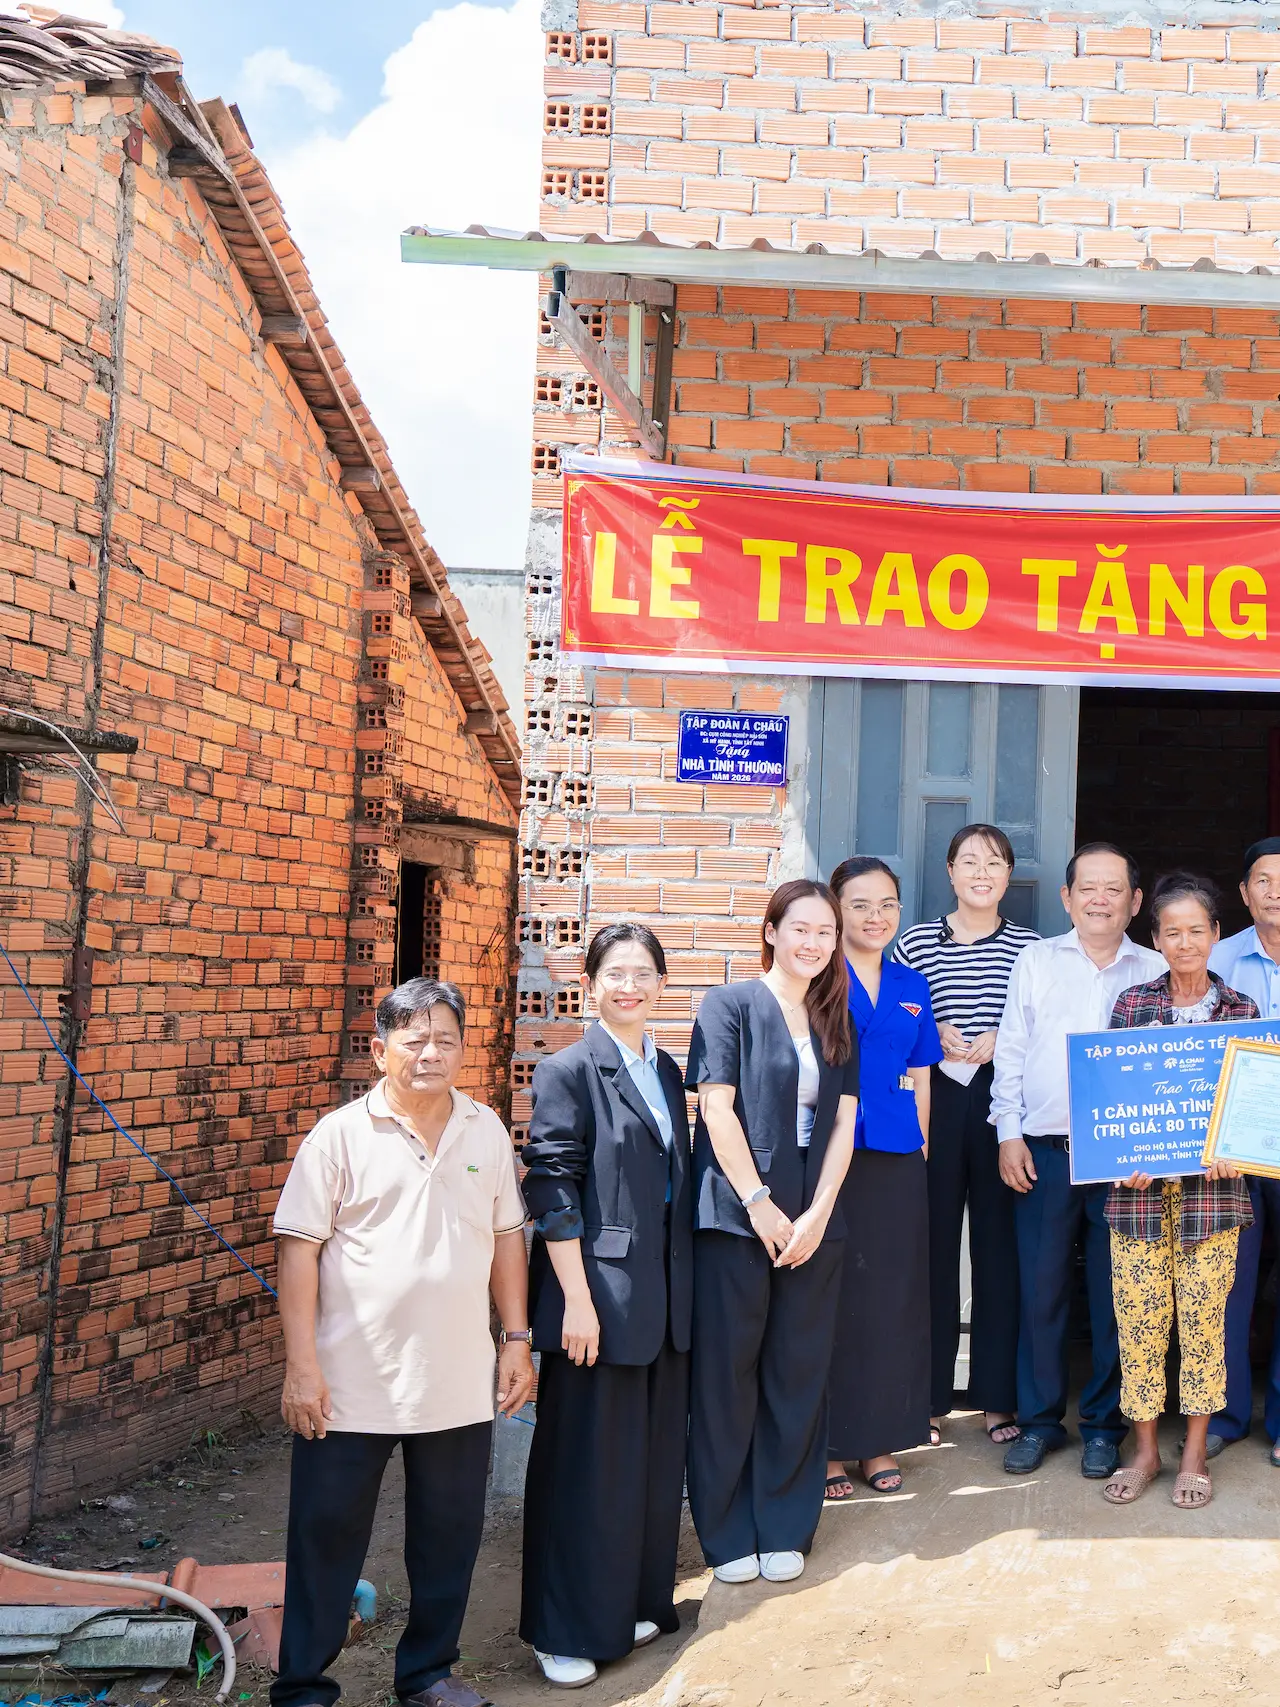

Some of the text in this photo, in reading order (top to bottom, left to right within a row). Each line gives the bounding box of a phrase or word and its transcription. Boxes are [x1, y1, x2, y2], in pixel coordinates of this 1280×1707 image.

[590, 496, 703, 620] LỄ
[741, 538, 990, 631] TRAO
[1021, 543, 1268, 660] TẶNG
[686, 716, 783, 732] TẬP ĐOÀN Á CHÂU
[715, 744, 750, 758] Tặng
[682, 756, 782, 774] NHÀ TÌNH THƯƠNG
[711, 772, 751, 782] NĂM 2026
[1085, 1045, 1112, 1061] TẬP
[1116, 1041, 1158, 1056] ĐOÀN
[1162, 1037, 1205, 1053] QUỐC
[1208, 1035, 1226, 1049] TẾ
[1152, 1080, 1183, 1095] Trao
[1091, 1108, 1099, 1120] 1
[1104, 1103, 1139, 1120] CĂN
[1142, 1100, 1177, 1116] NHÀ
[1093, 1123, 1125, 1140] (TRỊ
[1129, 1118, 1162, 1135] GIÁ:
[1165, 1119, 1185, 1132] 80
[1133, 1143, 1151, 1153] CHO
[1152, 1141, 1164, 1152] HỘ
[1166, 1139, 1178, 1150] BÀ
[1116, 1154, 1128, 1164] XÃ
[1130, 1153, 1143, 1163] MỸ
[1144, 1152, 1170, 1163] HẠNH,
